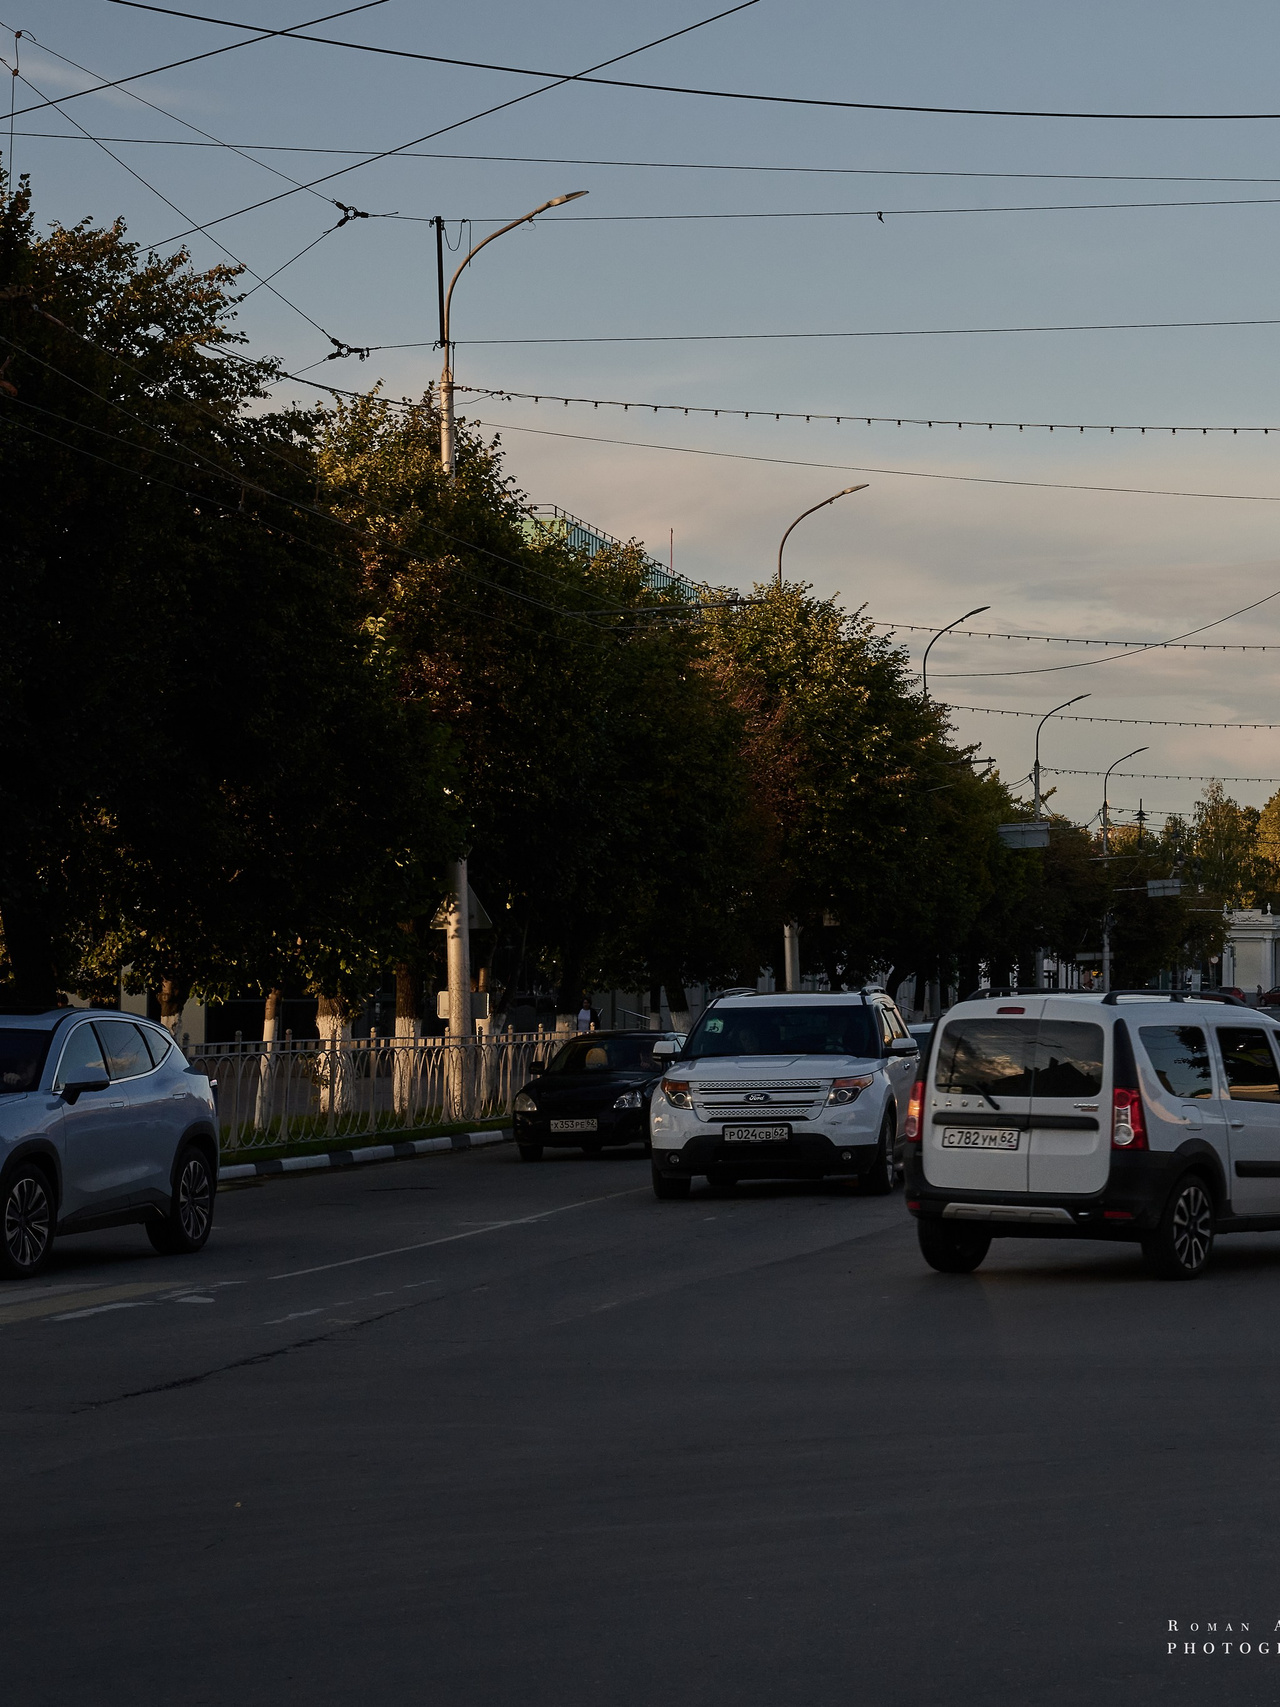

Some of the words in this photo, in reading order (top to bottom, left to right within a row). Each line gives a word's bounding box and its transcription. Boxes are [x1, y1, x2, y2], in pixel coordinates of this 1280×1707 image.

[932, 1099, 984, 1108] LADA
[729, 1129, 772, 1140] Р024СВ
[773, 1128, 785, 1137] 62
[947, 1130, 998, 1146] С782УМ
[1000, 1131, 1014, 1143] 62
